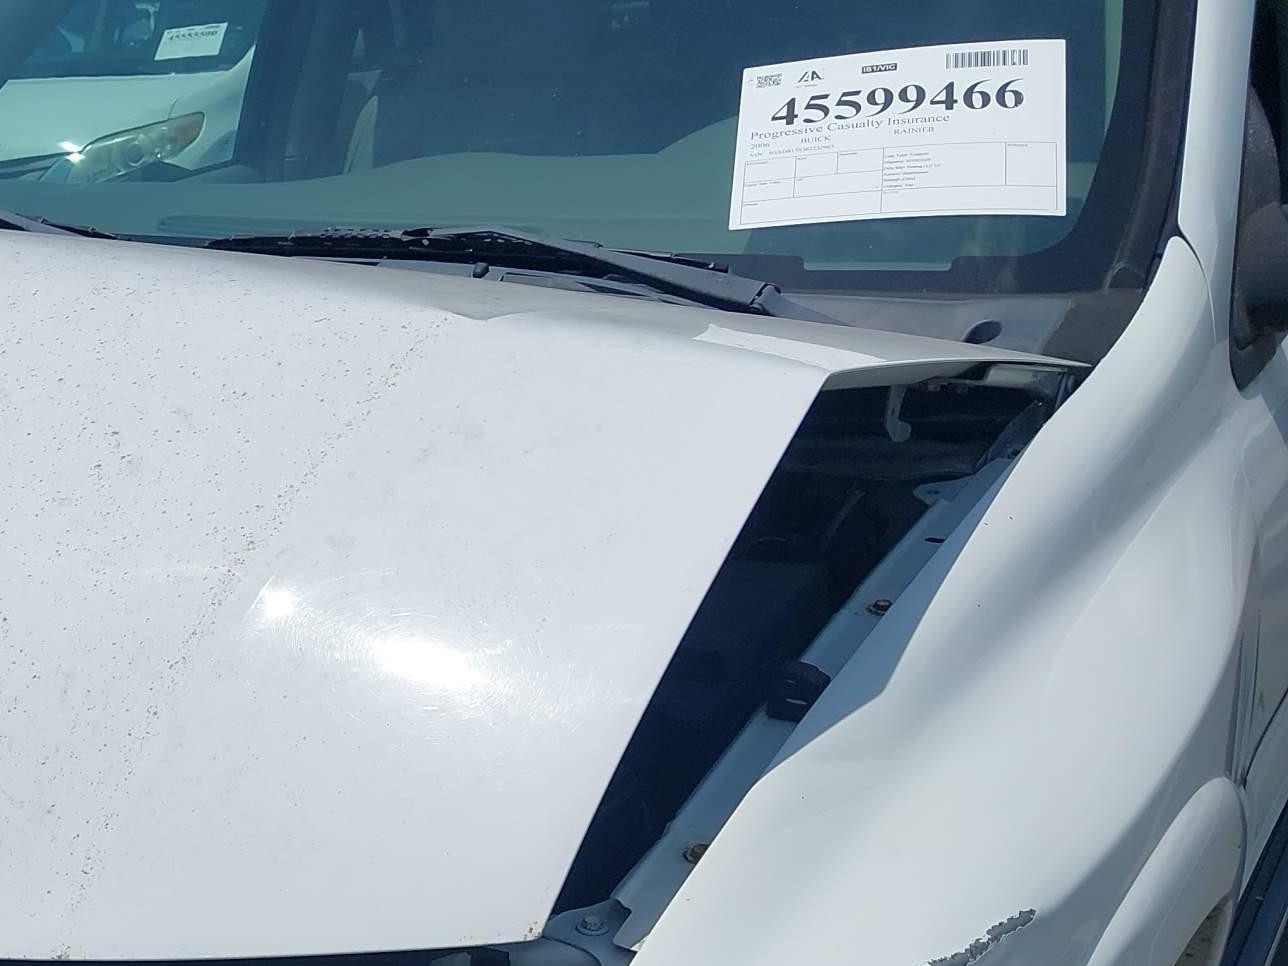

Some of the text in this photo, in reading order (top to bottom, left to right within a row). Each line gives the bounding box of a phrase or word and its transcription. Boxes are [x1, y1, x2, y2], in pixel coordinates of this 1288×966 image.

[771, 78, 1024, 126] 45599466
[750, 114, 950, 141] Progressive Casualty Insurance
[893, 126, 935, 135] RAINIER
